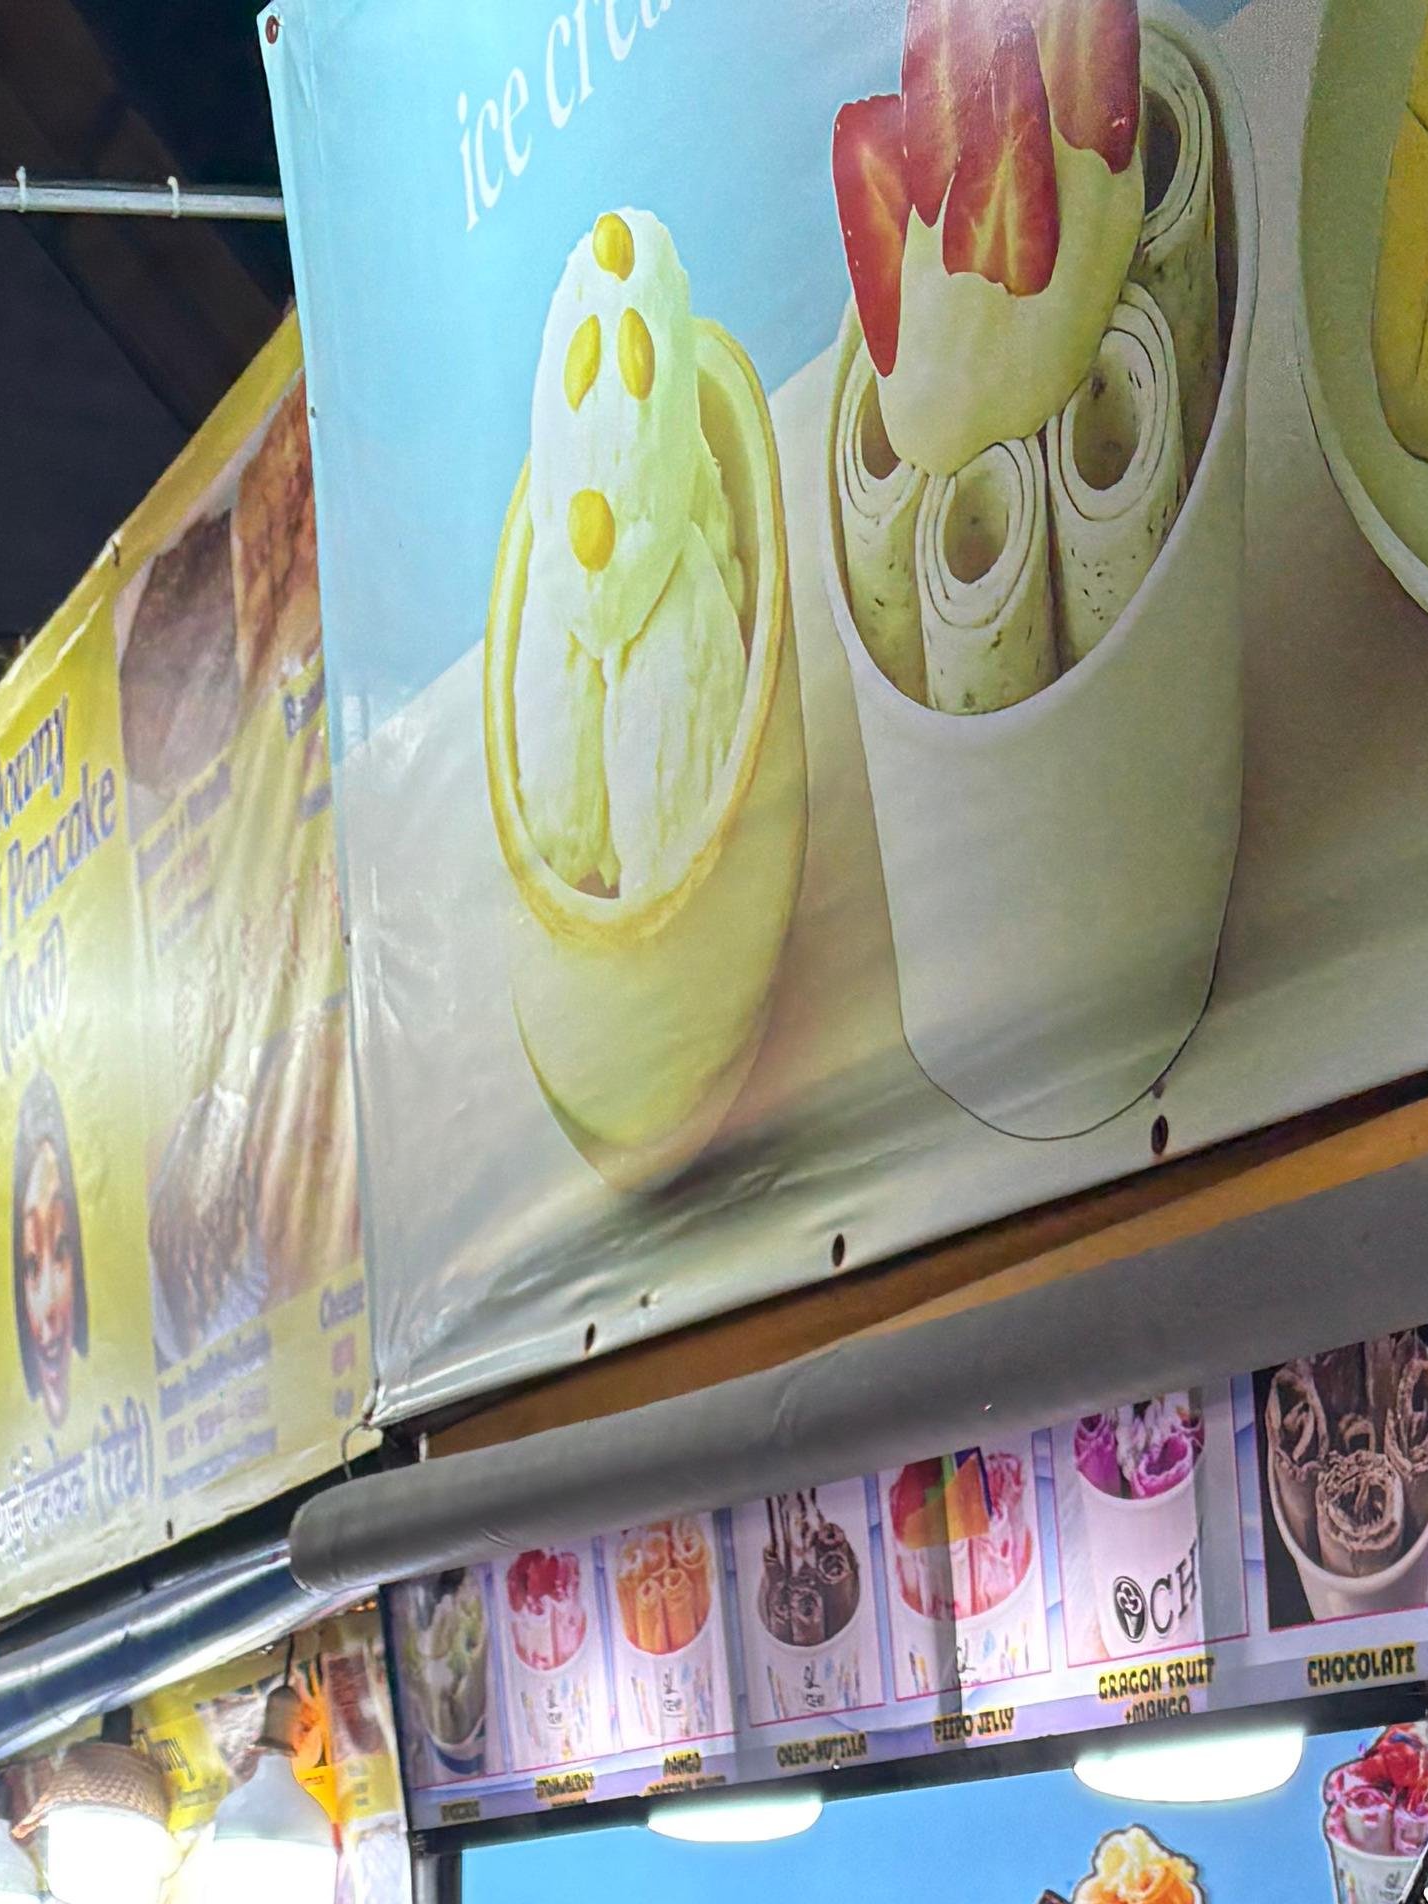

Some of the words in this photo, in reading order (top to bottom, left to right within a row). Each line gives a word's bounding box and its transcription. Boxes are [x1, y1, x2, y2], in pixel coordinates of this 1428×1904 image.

[458, 66, 532, 232] ice
[545, 0, 671, 129] cre
[1166, 1657, 1215, 1689] FRUIT
